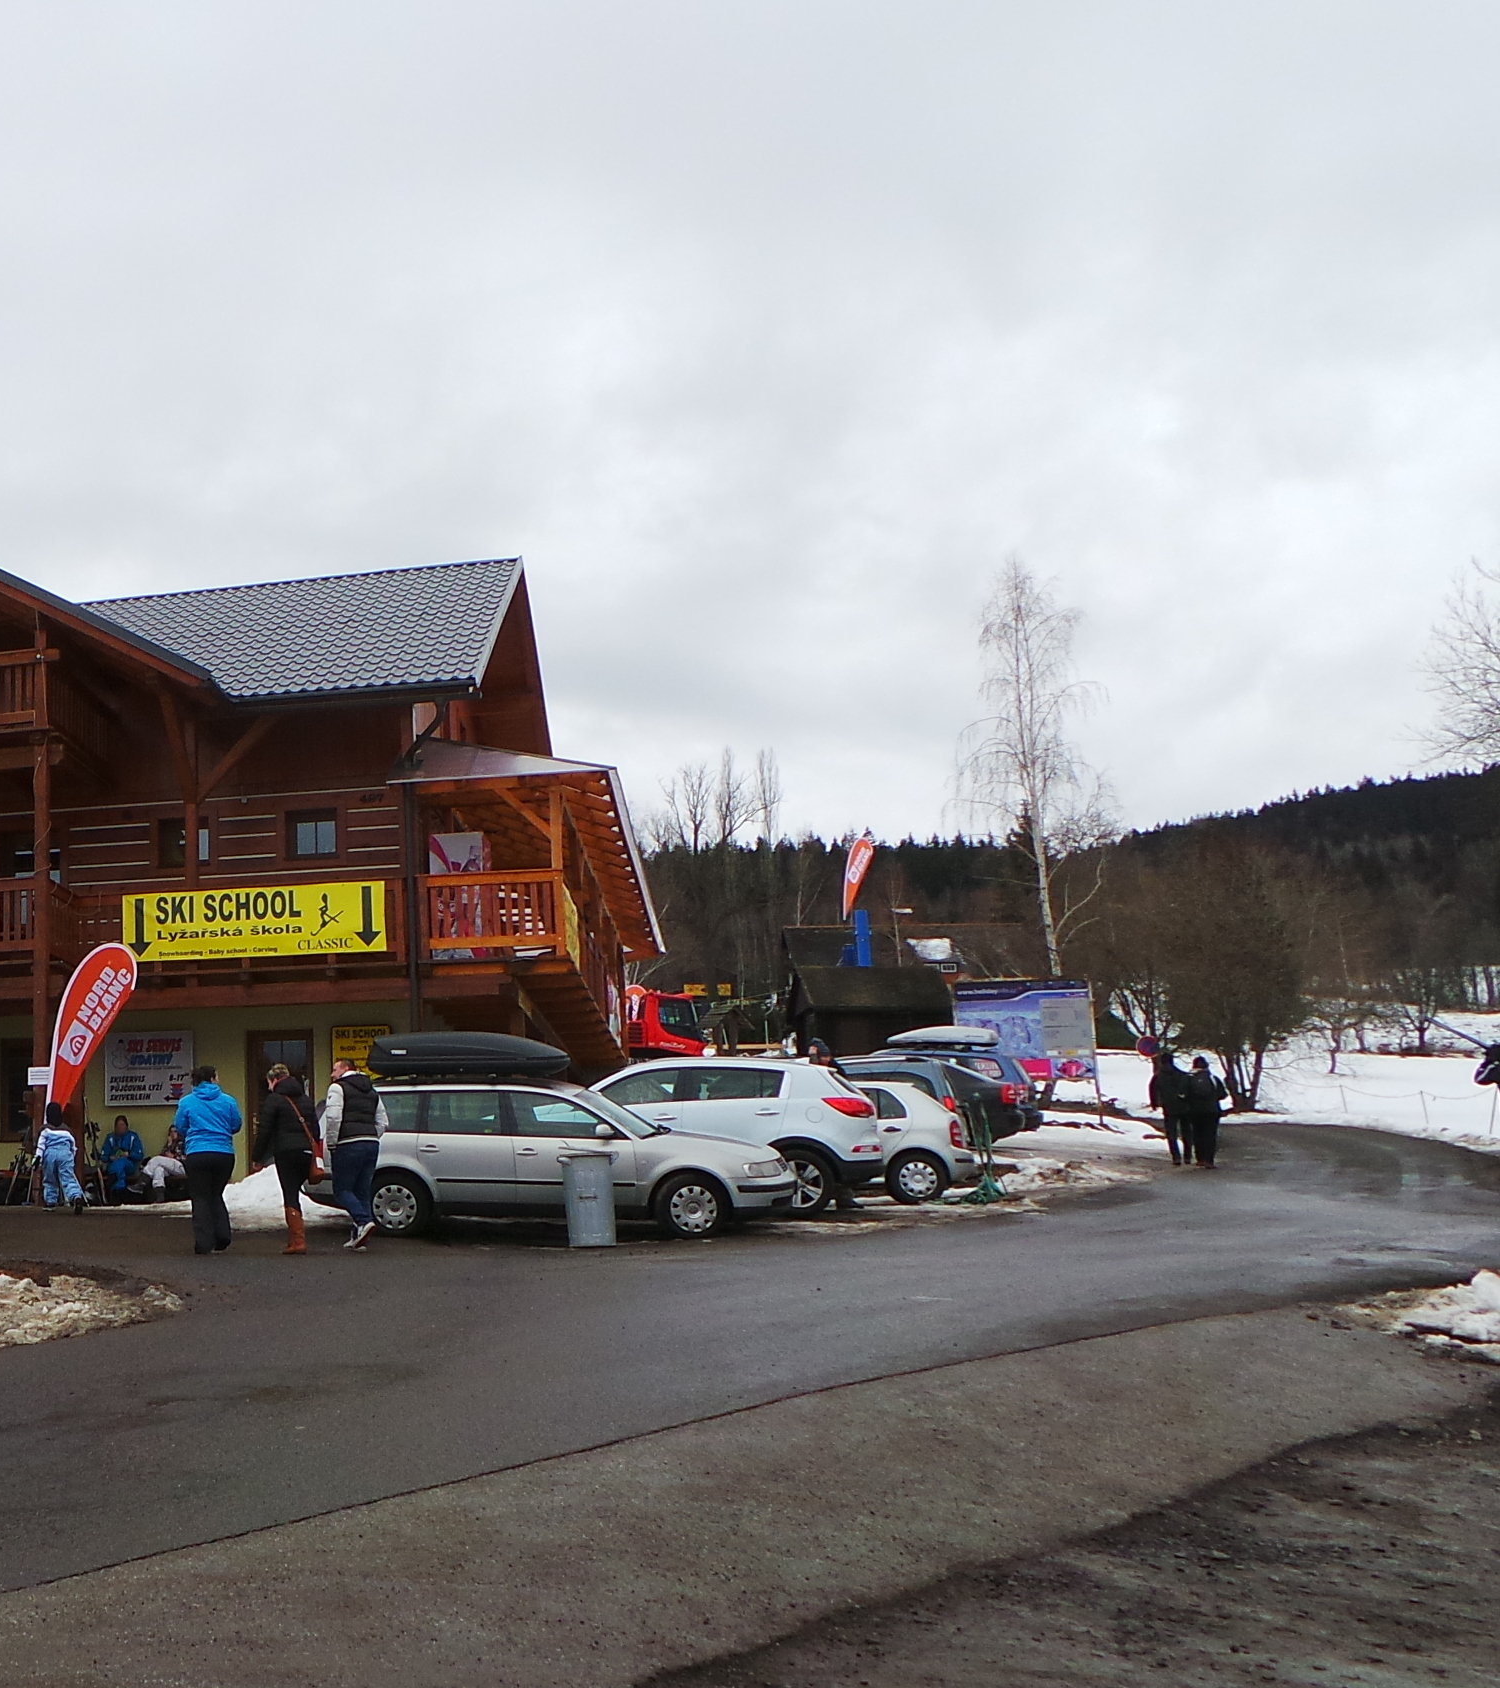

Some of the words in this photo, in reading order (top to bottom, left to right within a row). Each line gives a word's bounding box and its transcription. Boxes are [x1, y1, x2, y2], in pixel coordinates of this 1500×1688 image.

[155, 896, 194, 925] SKI
[203, 890, 302, 922] SCHOOL
[157, 926, 243, 942] Lyžařská
[250, 924, 303, 936] škola
[158, 950, 204, 958] Snowboarding
[208, 948, 224, 956] Baby
[252, 946, 278, 954] Carving
[298, 938, 354, 952] CLASSIC
[76, 966, 116, 1022] NORD
[88, 968, 132, 1031] BLANC
[335, 1030, 350, 1039] SKI
[126, 1038, 144, 1052] SKI
[146, 1038, 182, 1052] SERVIS
[110, 1075, 145, 1083] SKISERVIS
[110, 1093, 151, 1101] SKIVERLEIH
